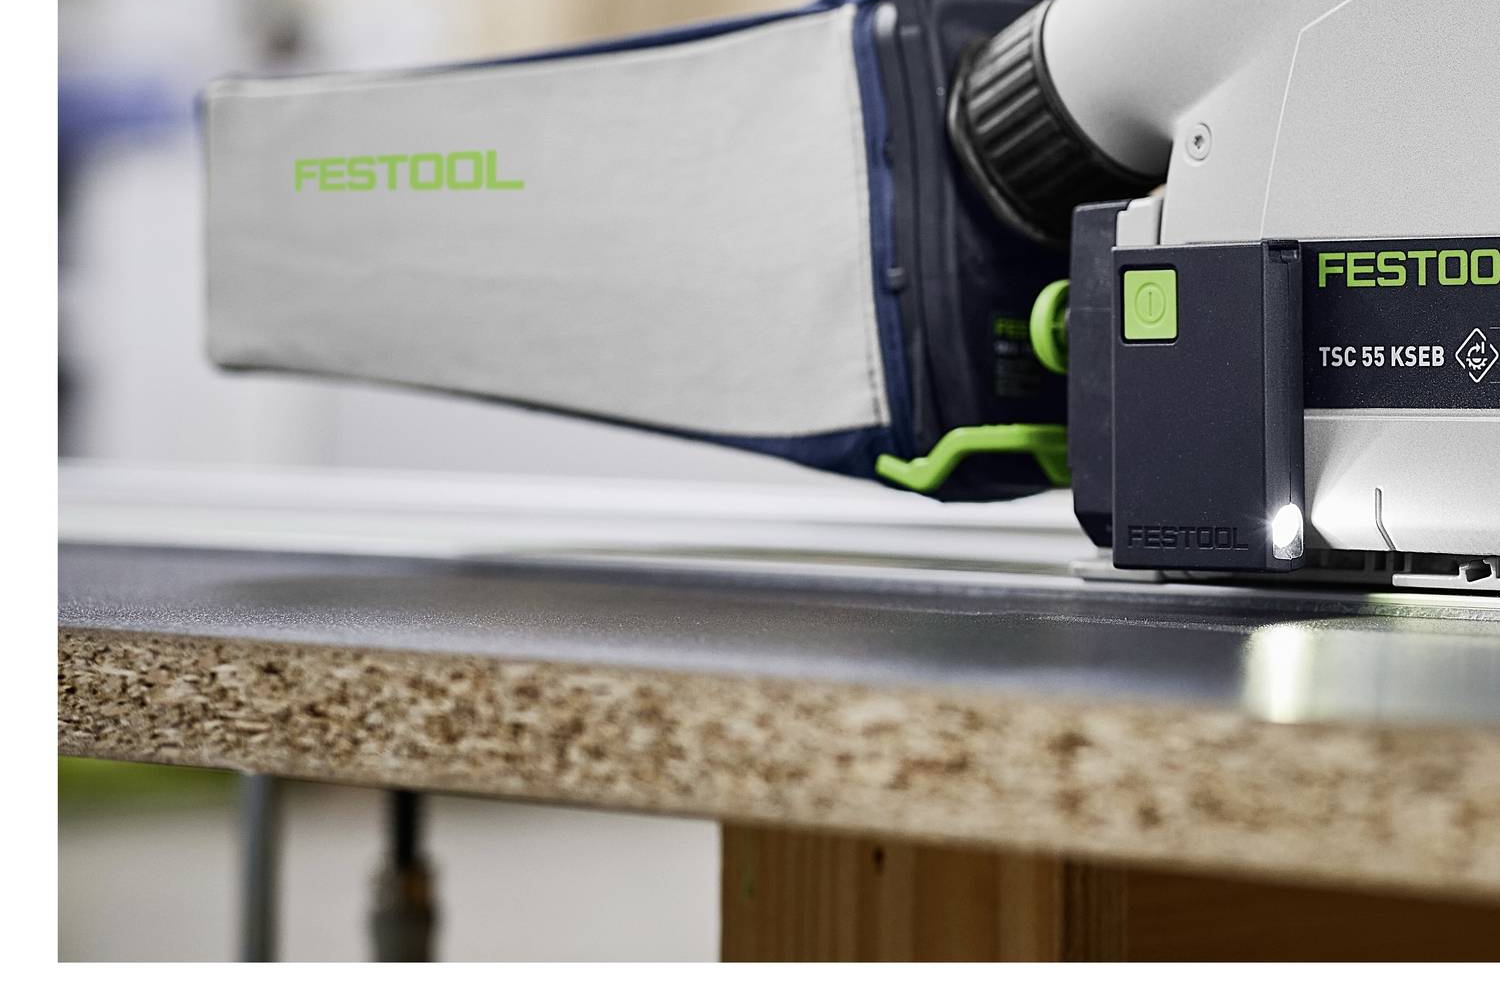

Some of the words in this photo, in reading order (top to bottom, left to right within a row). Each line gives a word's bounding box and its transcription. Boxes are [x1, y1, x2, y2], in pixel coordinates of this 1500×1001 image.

[294, 150, 526, 192] FESTOOL
[1319, 346, 1356, 367] TSC
[1362, 346, 1385, 367] 55
[1391, 346, 1445, 367] KSEB
[1127, 525, 1249, 550] FESTOOL
